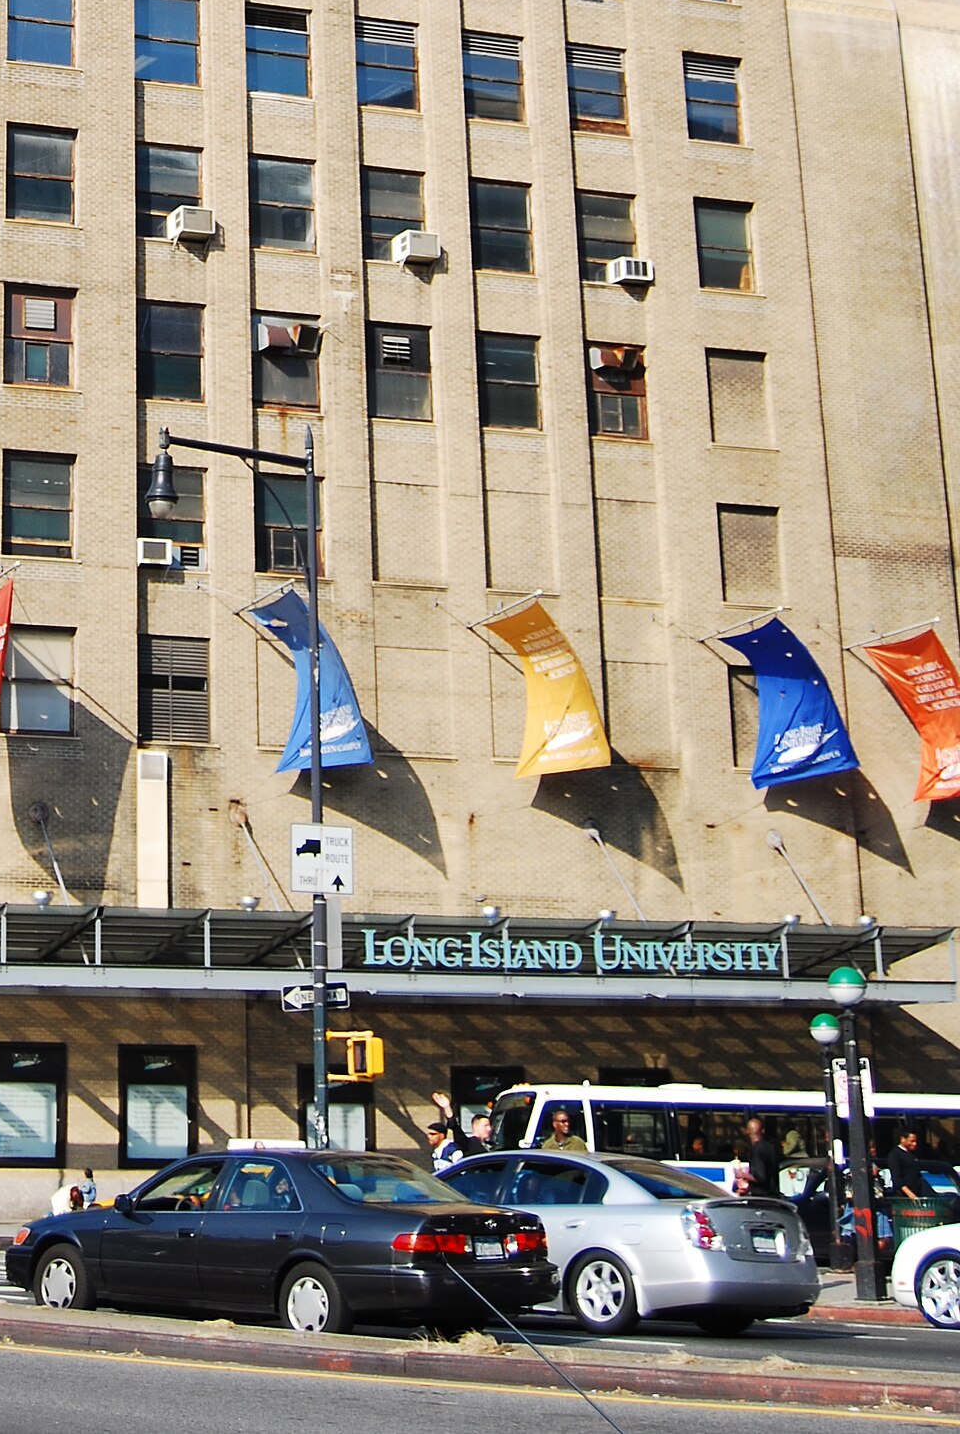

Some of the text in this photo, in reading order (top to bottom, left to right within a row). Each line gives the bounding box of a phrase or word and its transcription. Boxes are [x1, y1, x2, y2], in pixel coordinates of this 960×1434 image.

[325, 836, 349, 847] TRUCK
[325, 853, 349, 864] ROUTE
[299, 875, 318, 886] THRU
[360, 929, 780, 971] LONG ISLAND UNIVERSITY
[294, 992, 313, 1003] ONE
